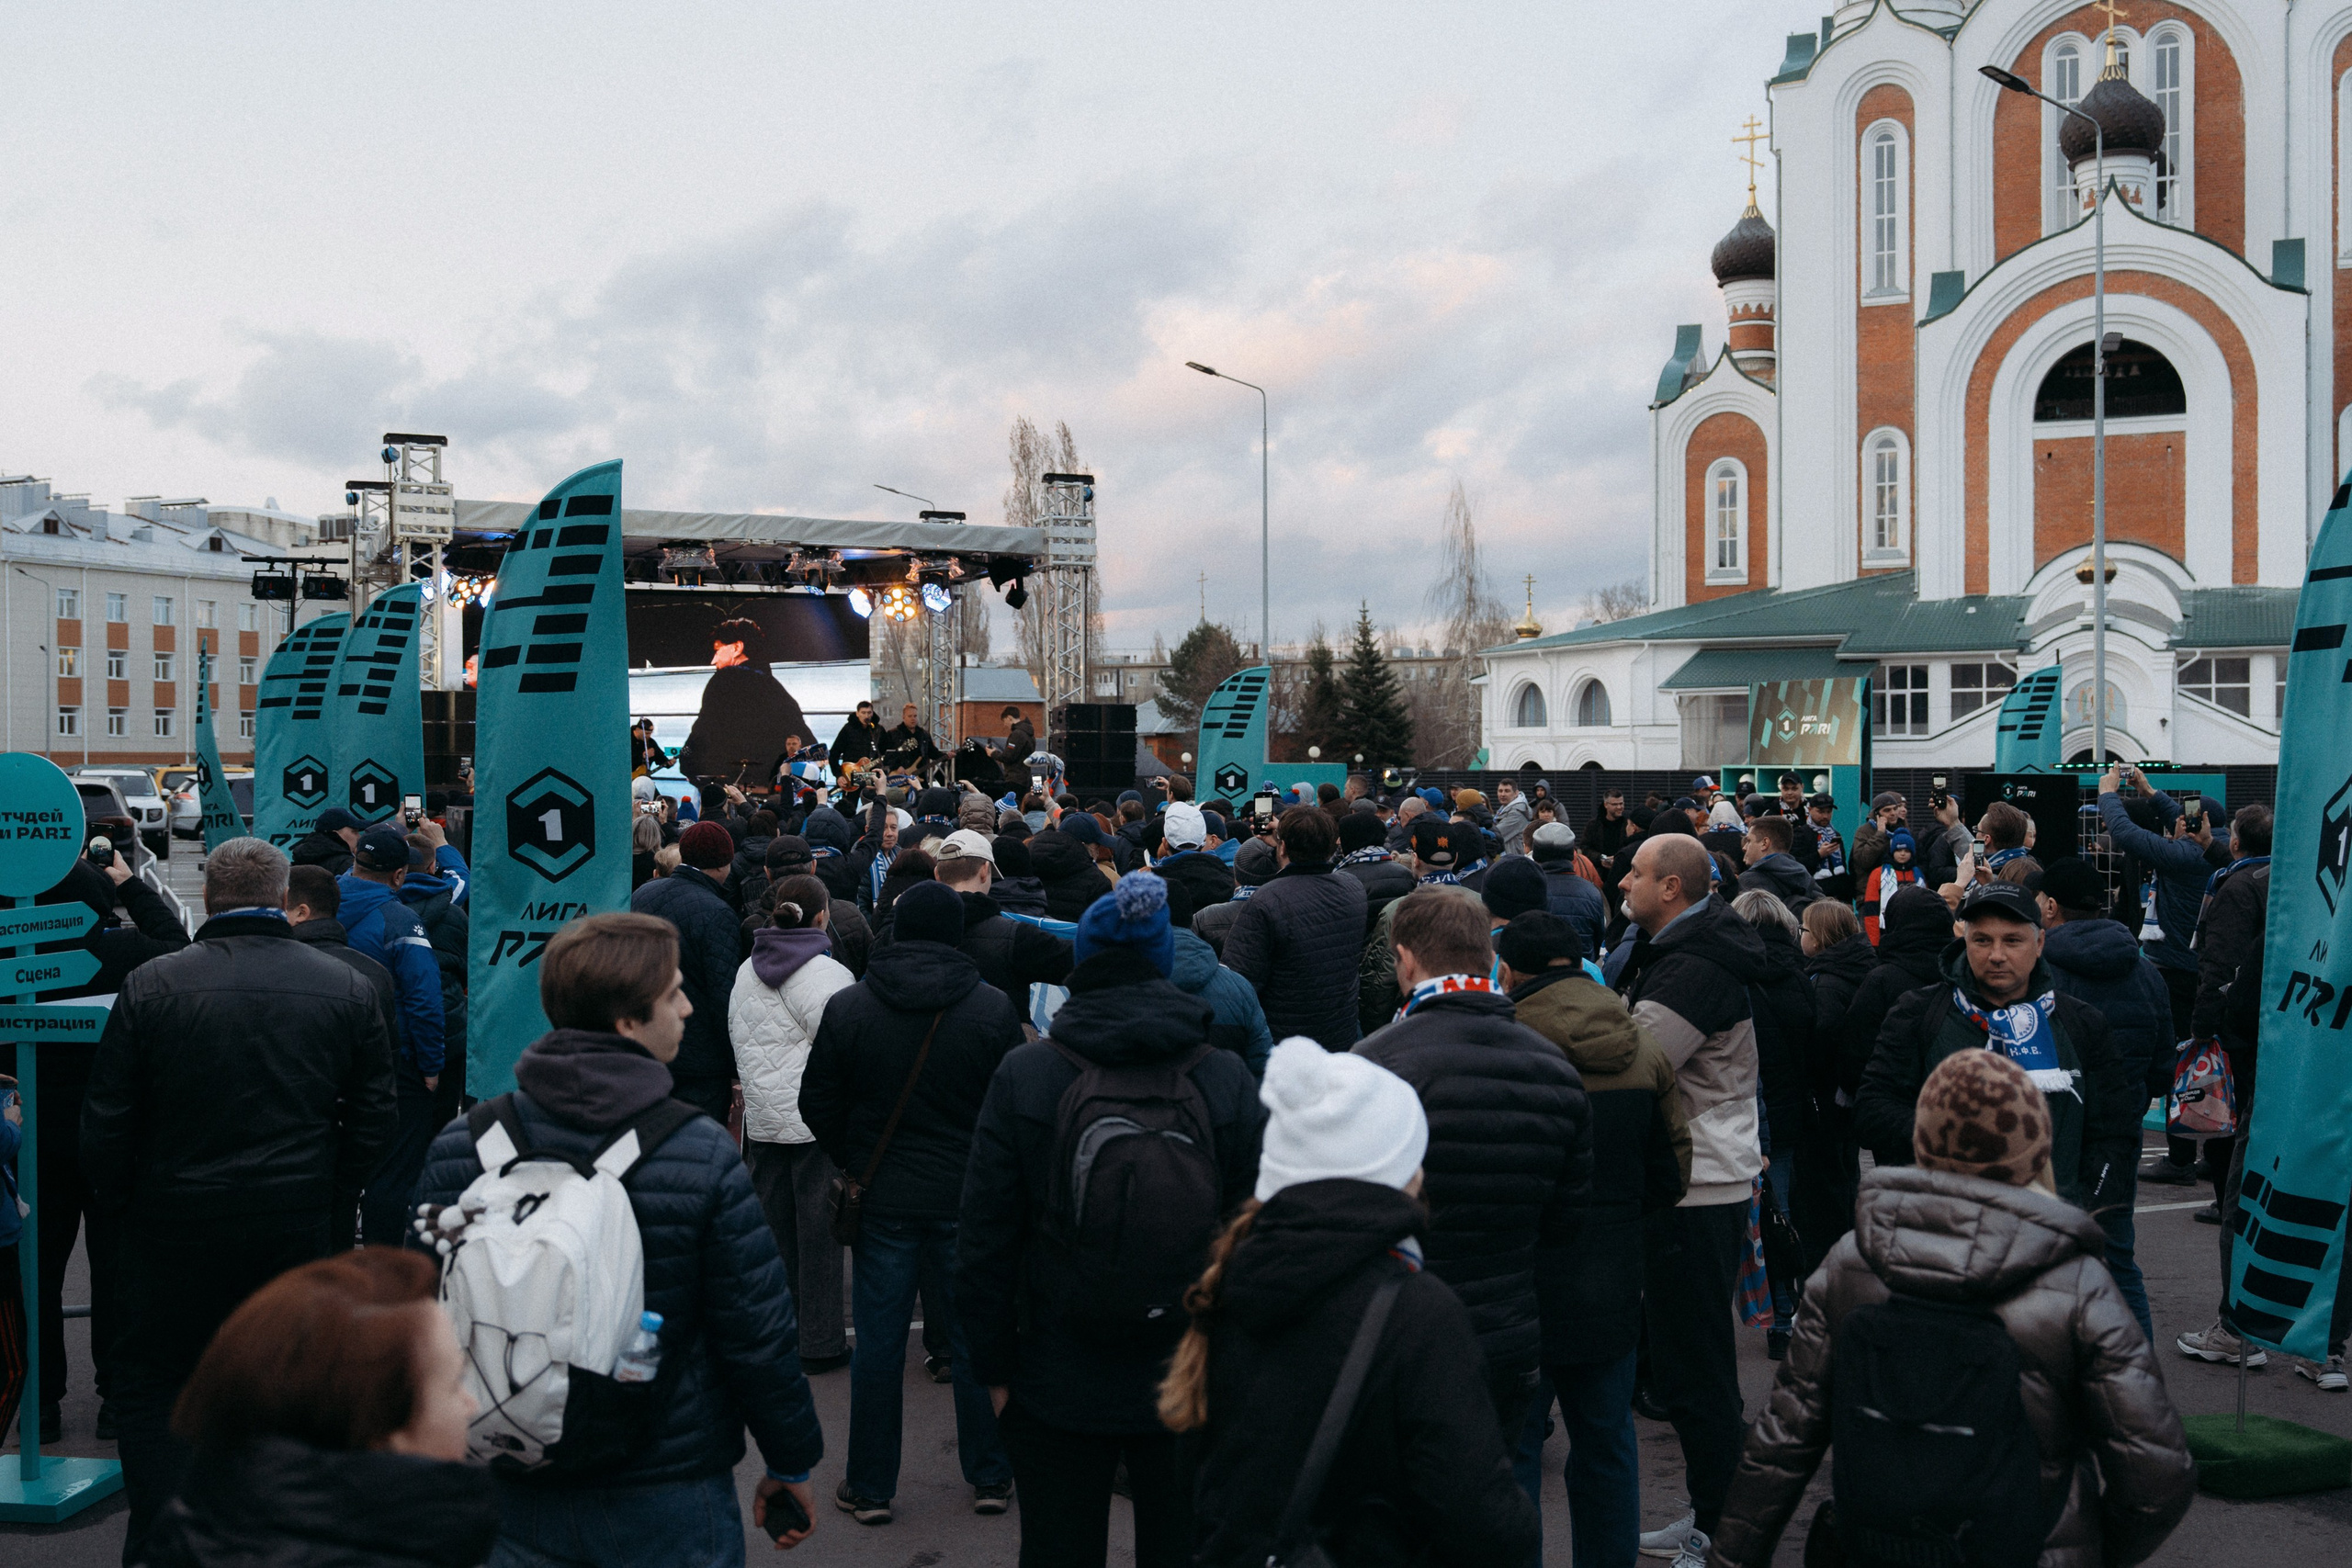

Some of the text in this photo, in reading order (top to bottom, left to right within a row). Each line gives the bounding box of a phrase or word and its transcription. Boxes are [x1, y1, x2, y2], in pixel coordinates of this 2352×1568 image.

[1801, 723, 1831, 735] PARI
[300, 774, 312, 790] 1
[1227, 775, 1235, 787] 1
[361, 784, 375, 803] 1
[0, 808, 62, 825] тчдей
[202, 813, 233, 829] ARI
[538, 809, 563, 840] 1
[17, 828, 72, 840] PARI
[1978, 884, 2019, 899] Факел
[520, 901, 588, 920] ЛИГА
[0, 916, 84, 935] астомизация
[16, 966, 61, 984] Сцена
[0, 1018, 96, 1032] истрация
